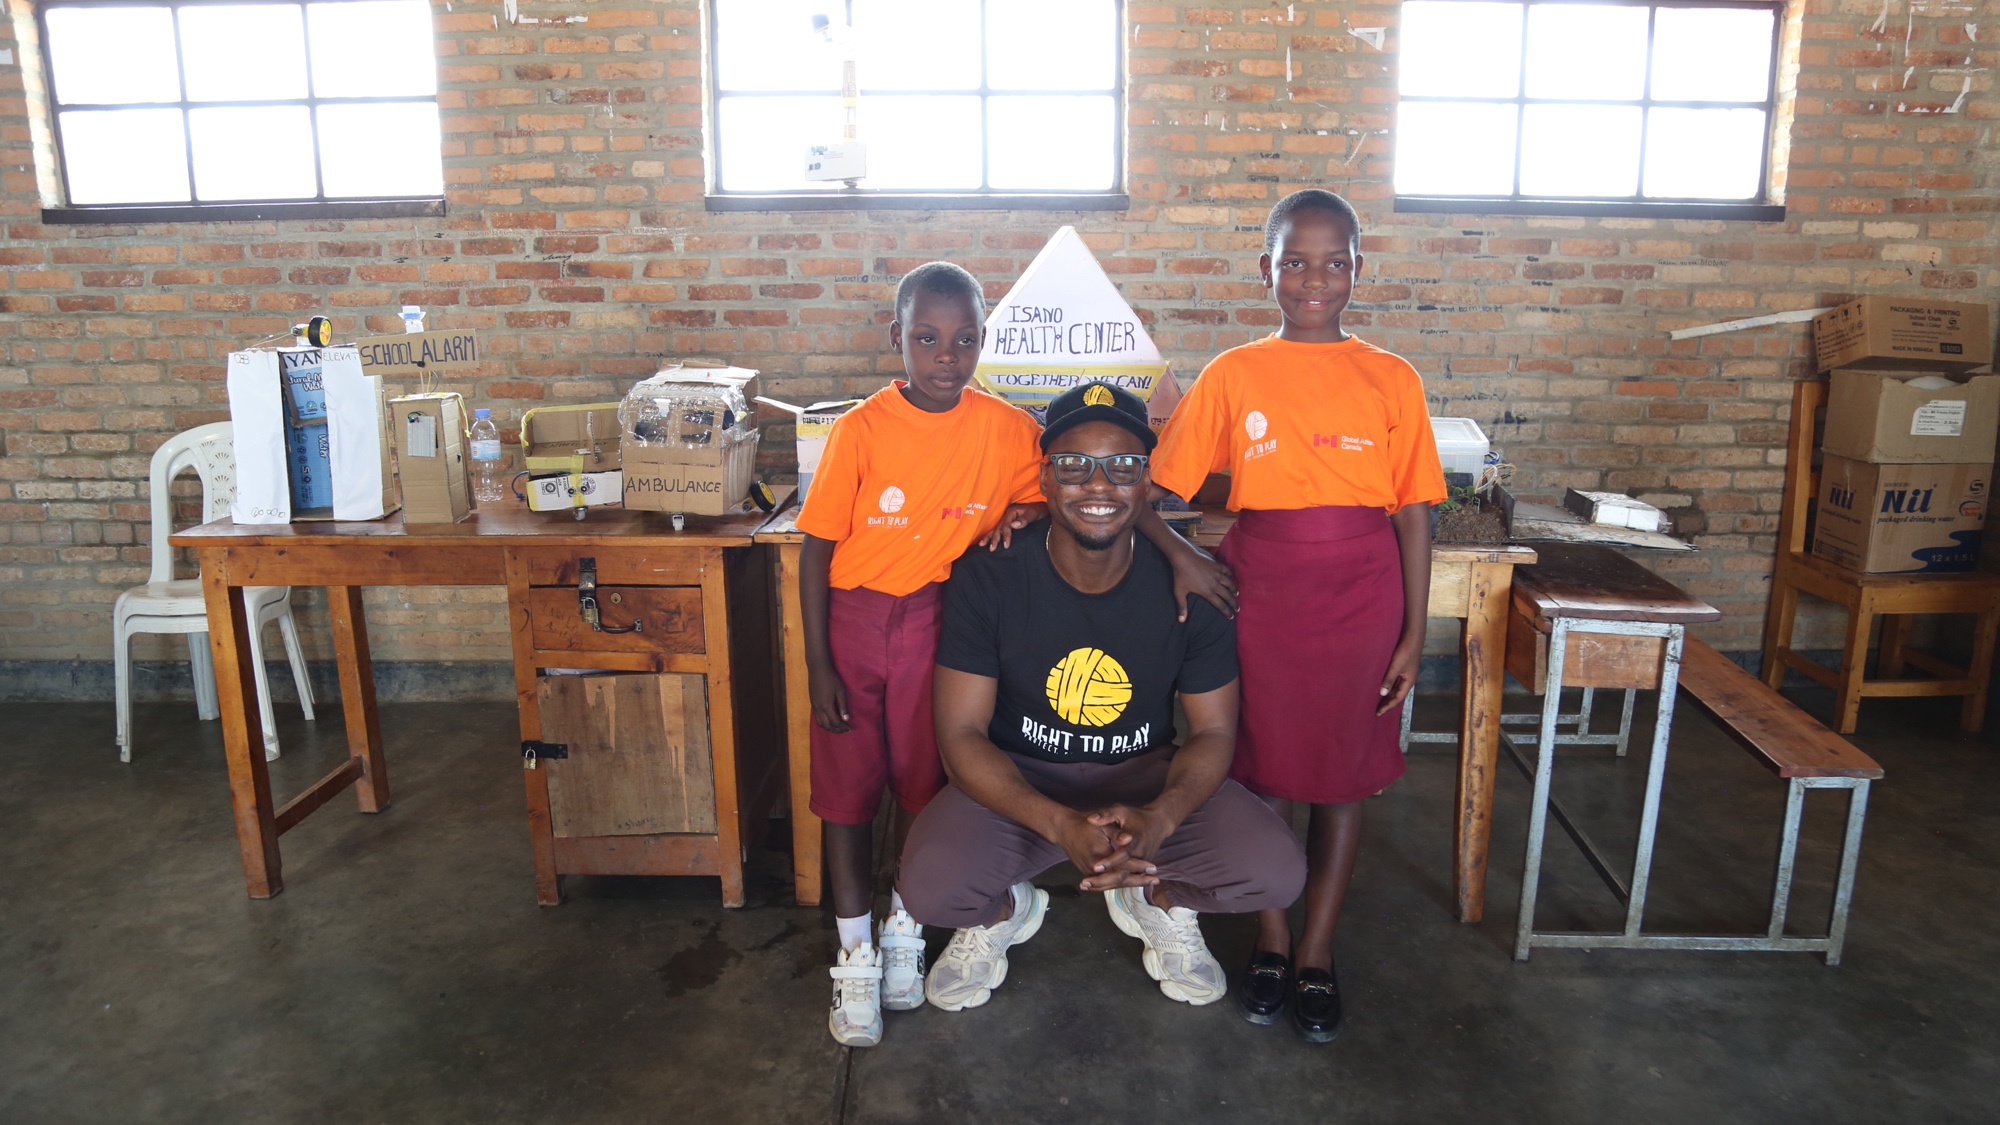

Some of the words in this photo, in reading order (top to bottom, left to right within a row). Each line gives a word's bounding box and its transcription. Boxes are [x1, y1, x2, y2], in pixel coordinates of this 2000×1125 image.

[1008, 305, 1063, 324] ISANO
[1890, 306, 1925, 314] PACKAGING
[994, 325, 1063, 355] HEALTH
[1068, 322, 1135, 355] CENTER
[361, 342, 416, 367] SCHOOL
[421, 335, 476, 363] ALARM
[990, 373, 1080, 387] TOGETHER
[1116, 374, 1152, 389] CAN!
[1255, 443, 1264, 455] TO
[1264, 438, 1277, 452] PLAY
[1341, 435, 1359, 444] Global
[1341, 443, 1363, 451] Canada
[625, 477, 722, 493] AMBULANCE
[1829, 487, 1855, 510] Nil
[1881, 489, 1933, 513] Nil
[868, 516, 885, 525] RIGHT
[887, 516, 894, 525] TO
[894, 516, 909, 525] PLAY
[1877, 516, 1908, 524] packaged
[1931, 554, 1942, 562] 12
[1021, 716, 1074, 750] RIGHT
[1079, 735, 1105, 753] TO
[1111, 722, 1150, 752] PLAY
